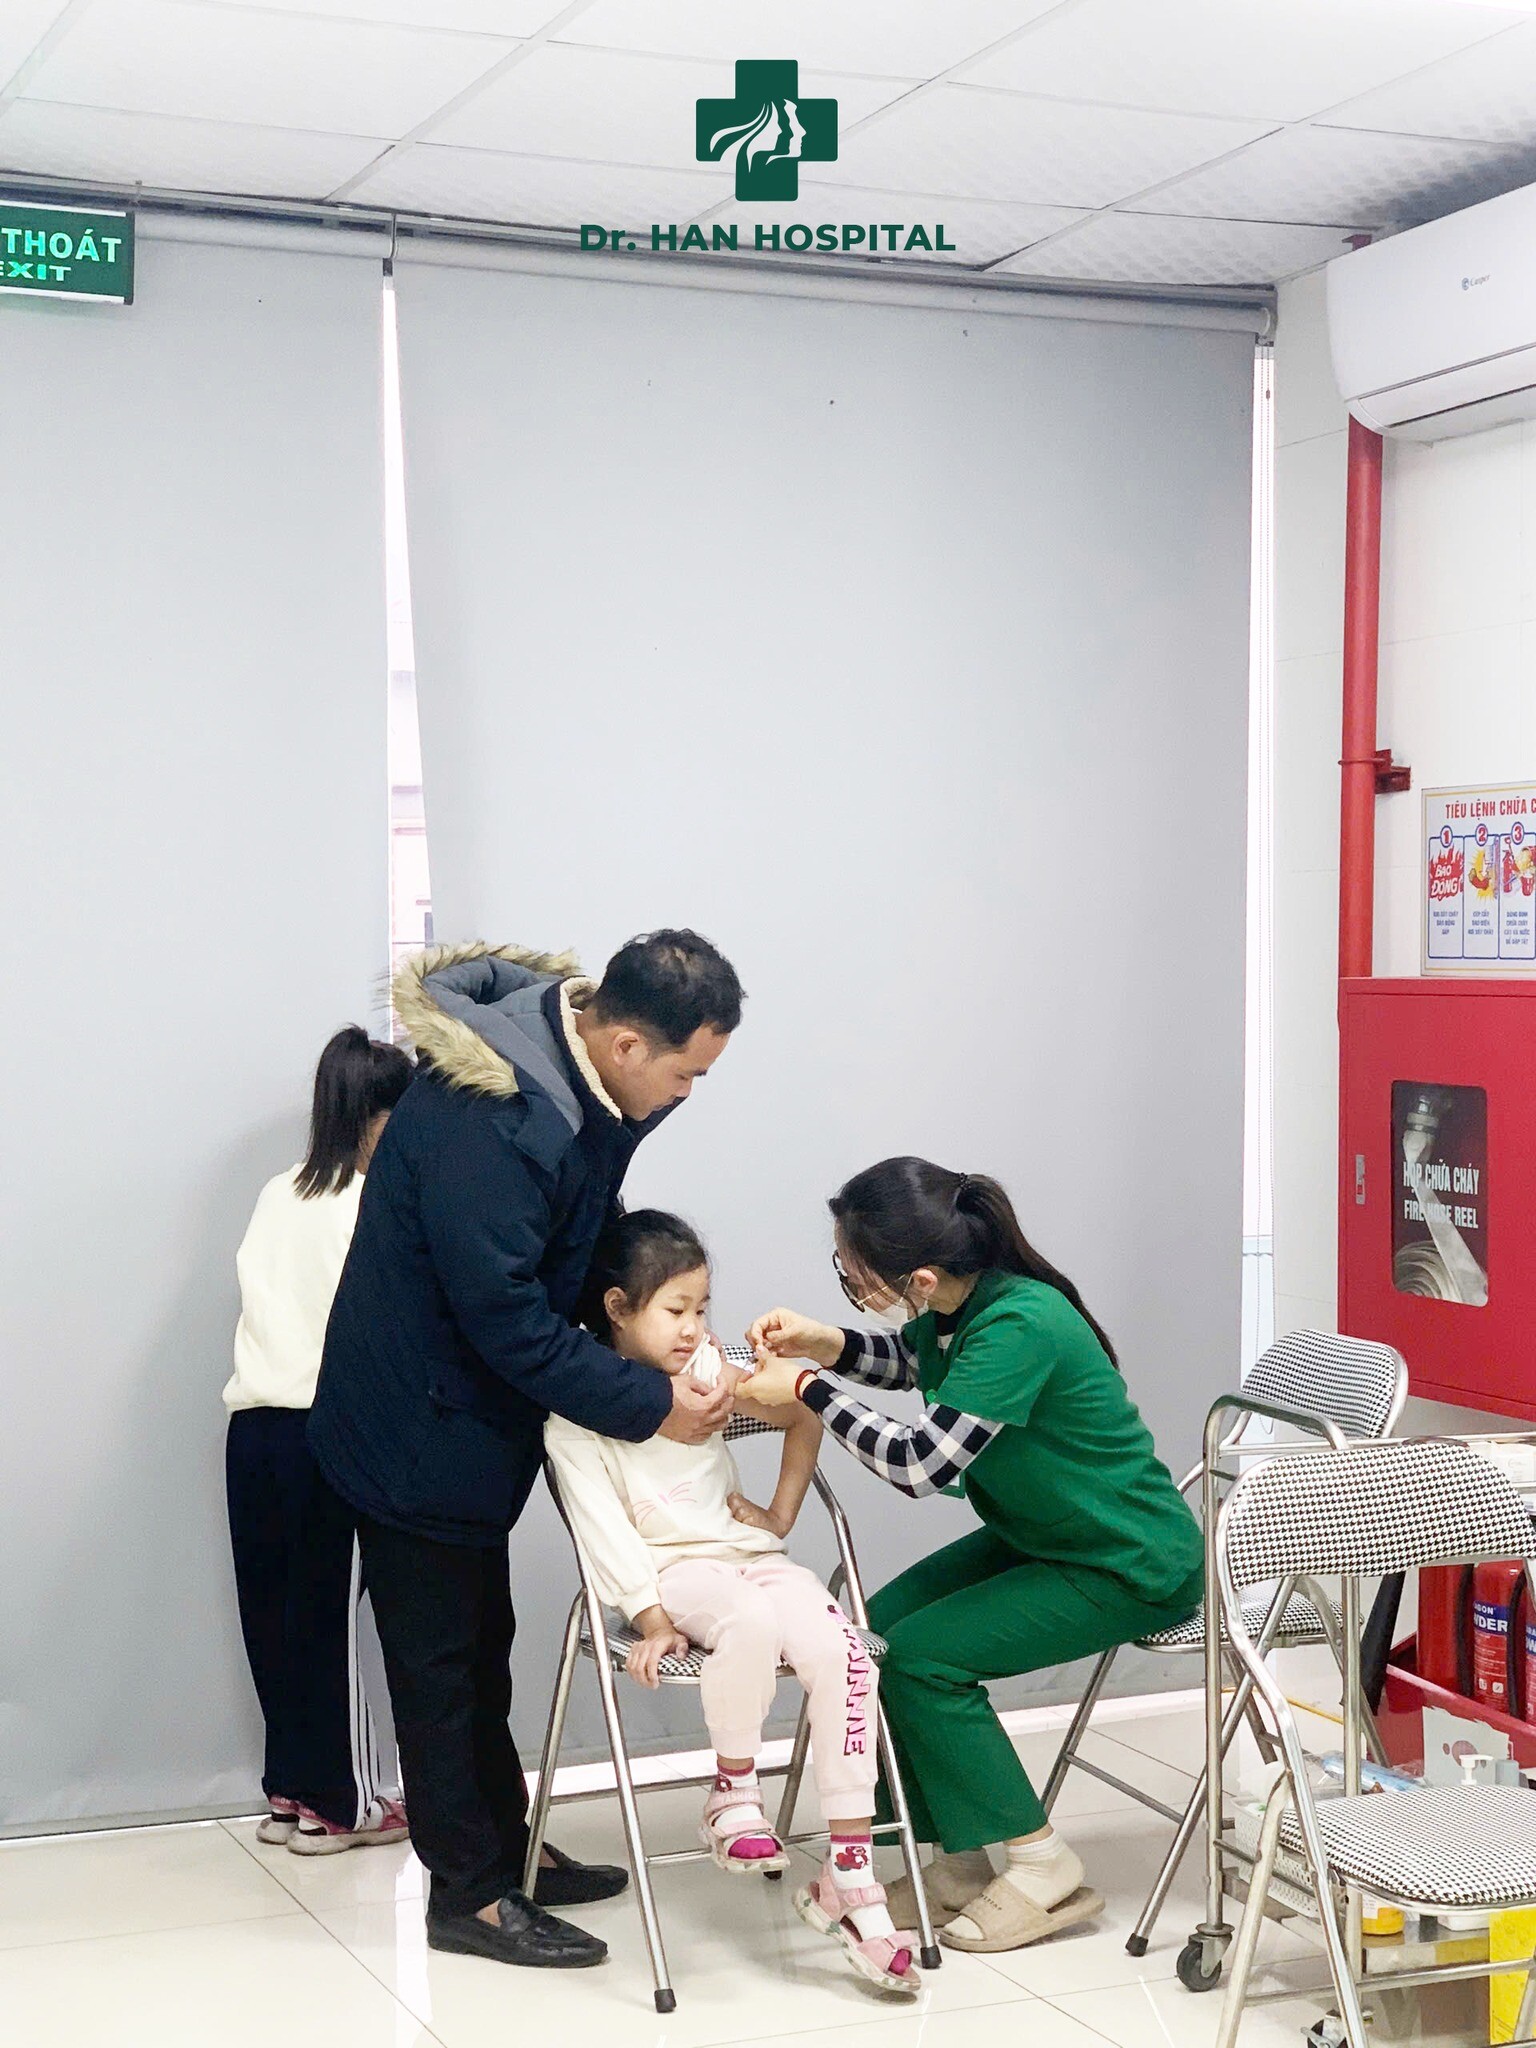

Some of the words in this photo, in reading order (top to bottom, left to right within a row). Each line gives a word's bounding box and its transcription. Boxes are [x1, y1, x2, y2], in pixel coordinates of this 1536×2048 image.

[1, 227, 122, 263] THOÁT
[1470, 798, 1496, 820] LỆNH
[1443, 830, 1450, 844] 1
[1478, 827, 1486, 842] 2
[1514, 825, 1522, 841] 3
[1453, 1163, 1480, 1195] CHÁY
[1454, 1206, 1479, 1229] REEL
